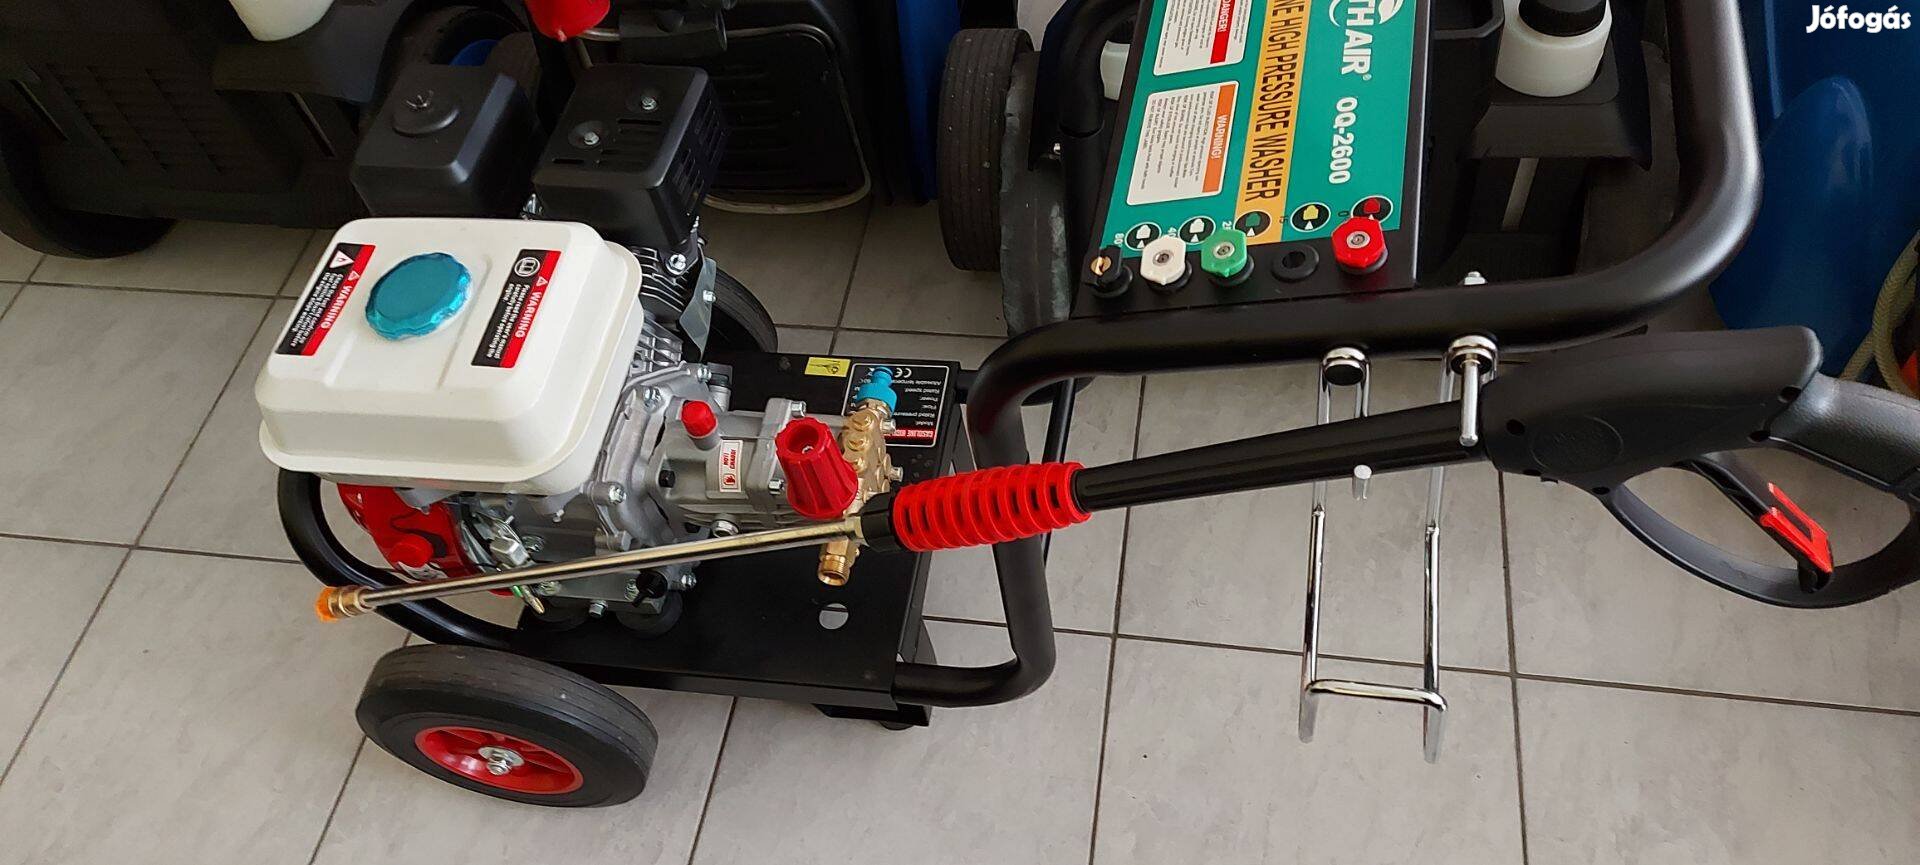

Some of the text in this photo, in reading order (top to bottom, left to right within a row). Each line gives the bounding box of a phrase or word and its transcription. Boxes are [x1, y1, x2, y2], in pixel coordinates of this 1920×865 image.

[1265, 17, 1302, 52] HIGH
[1254, 53, 1298, 132] PRESSURE
[1211, 114, 1229, 160] WARNING!
[1328, 97, 1358, 184] OQ-2600
[1244, 133, 1288, 202] WASHER
[321, 285, 352, 328] WARNING
[515, 291, 541, 338] WARNING
